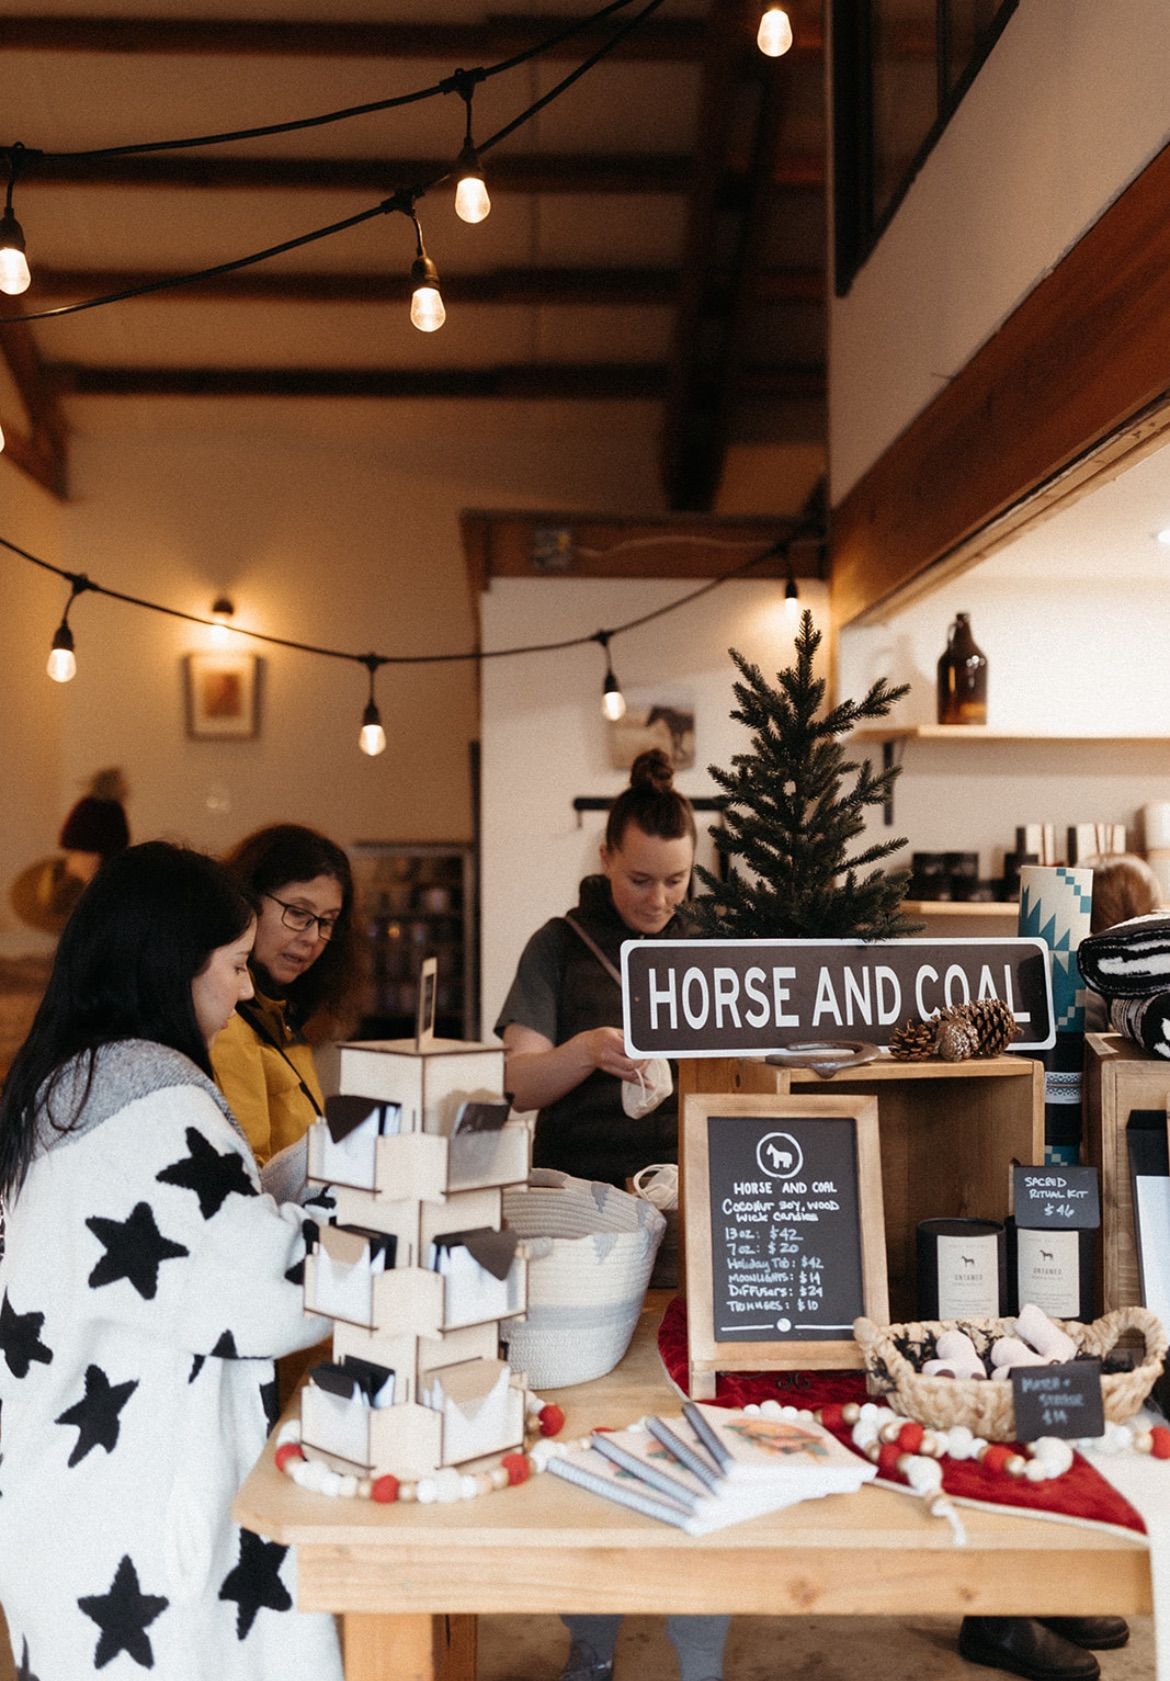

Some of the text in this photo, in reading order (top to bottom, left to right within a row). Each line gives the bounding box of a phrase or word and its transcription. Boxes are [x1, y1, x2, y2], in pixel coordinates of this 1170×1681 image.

[649, 964, 1030, 1030] HORSE AND COAL
[733, 1181, 837, 1195] HORSE AND COAL
[770, 1224, 804, 1241] $42
[801, 1256, 824, 1269] $42
[799, 1271, 820, 1285] $14
[799, 1285, 823, 1297] $24
[797, 1298, 819, 1312] $10
